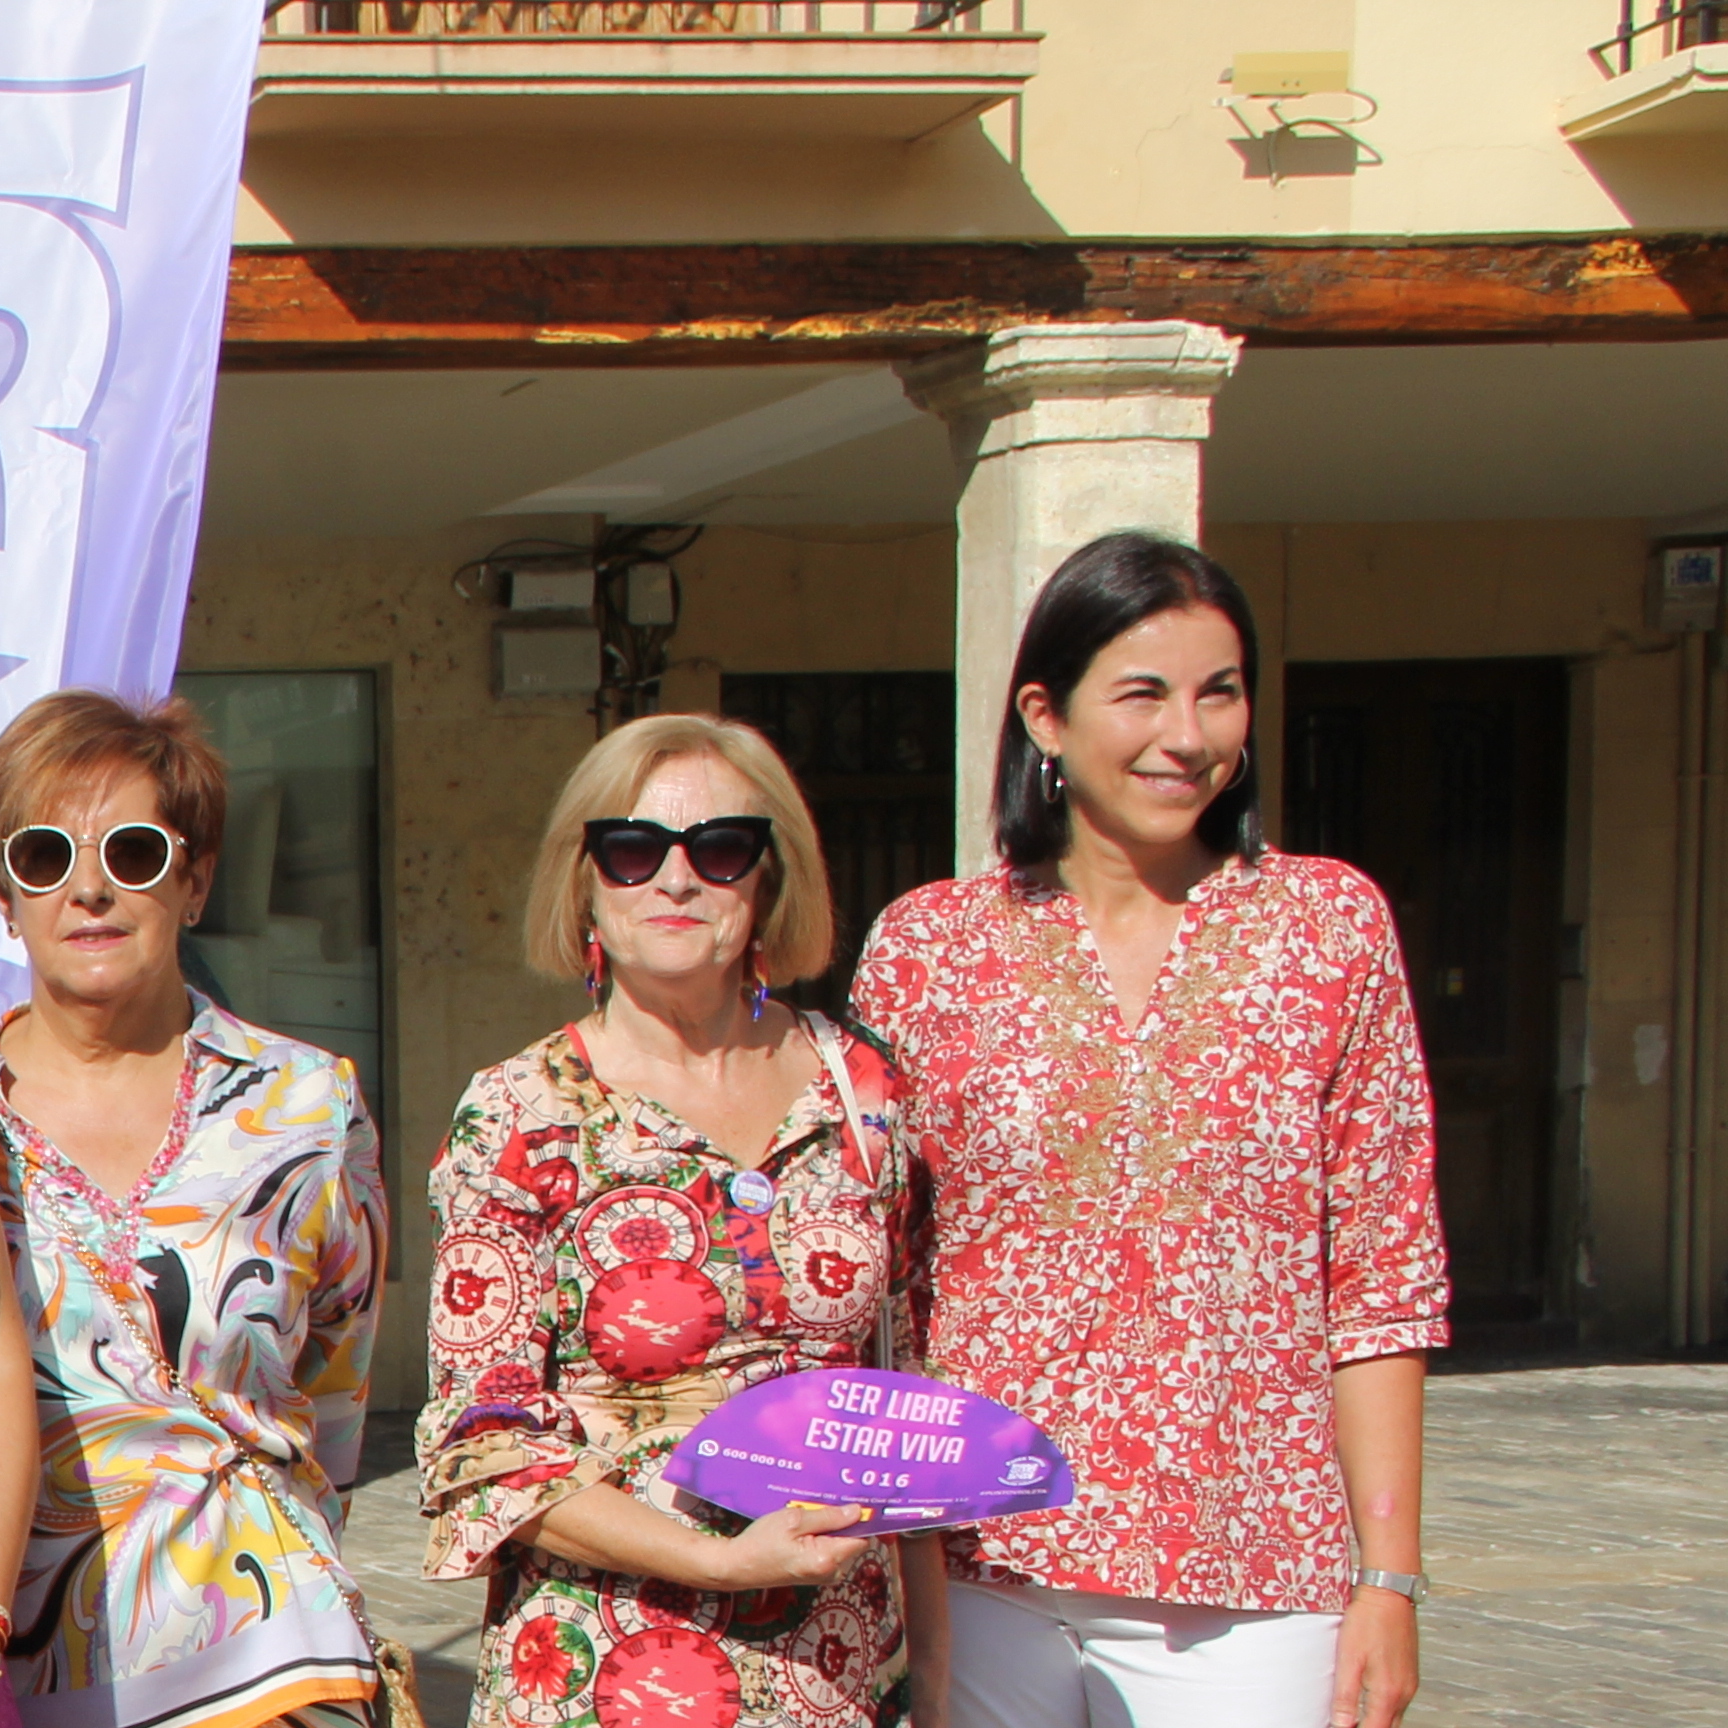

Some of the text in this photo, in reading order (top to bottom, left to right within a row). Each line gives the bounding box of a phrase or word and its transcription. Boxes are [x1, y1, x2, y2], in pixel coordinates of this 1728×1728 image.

[826, 1378, 967, 1427] SER LIBRE
[804, 1417, 966, 1464] ESTAR VIVA
[722, 1448, 803, 1471] 600 000 016
[861, 1470, 910, 1488] 016
